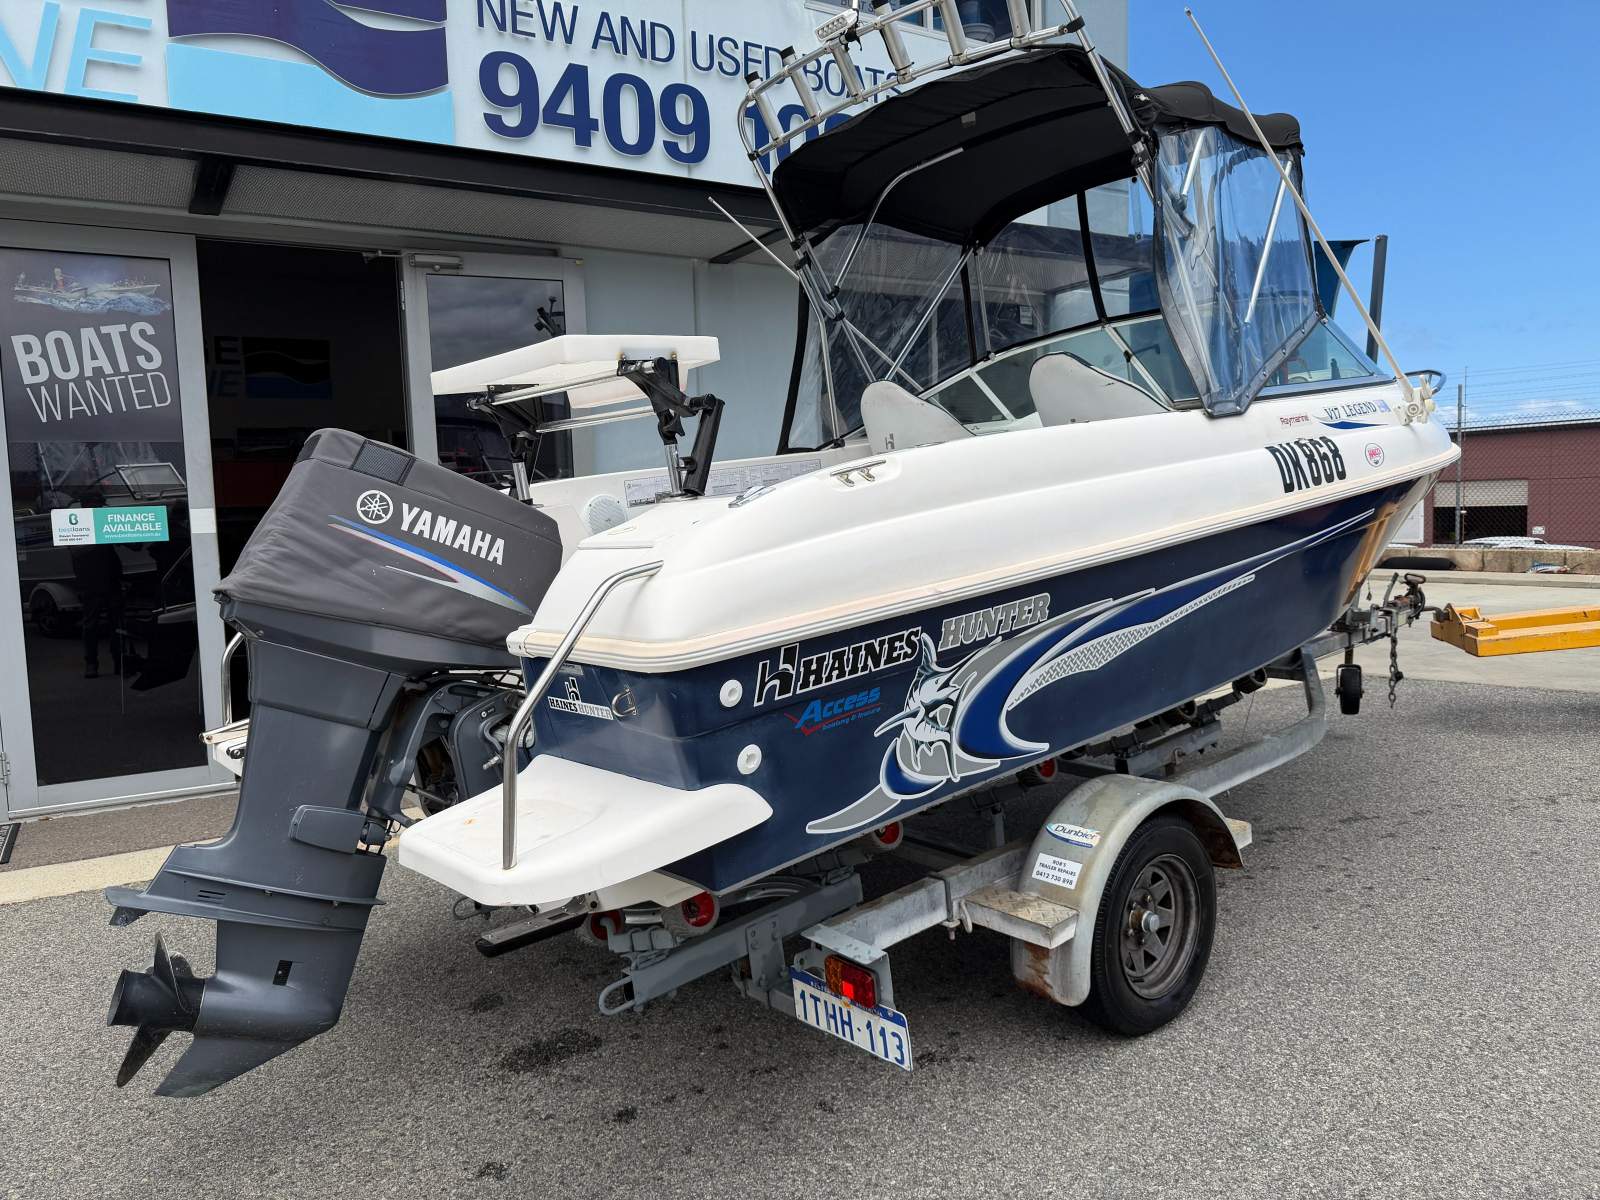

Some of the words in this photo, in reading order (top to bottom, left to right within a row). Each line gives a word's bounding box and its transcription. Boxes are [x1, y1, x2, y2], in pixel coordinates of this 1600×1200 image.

[477, 0, 579, 44] NEW
[591, 11, 676, 63] AND
[690, 30, 786, 84] USED
[478, 50, 711, 165] 9409
[744, 103, 856, 175] 10
[11, 321, 163, 386] BOATS
[26, 371, 172, 424] WANTED
[1325, 406, 1341, 421] V17
[1343, 401, 1378, 417] LEGEND
[102, 522, 163, 533] AVAILABLE
[107, 512, 156, 523] FINANCE
[400, 502, 505, 566] YAMAHA
[796, 626, 923, 695] HAINES
[937, 592, 1051, 652] HUNTER
[795, 687, 881, 729] Access
[1054, 824, 1096, 840] Dunbier
[1035, 870, 1050, 879] 0412
[1039, 862, 1057, 872] TRAILER
[1057, 868, 1077, 876] REPAIRS
